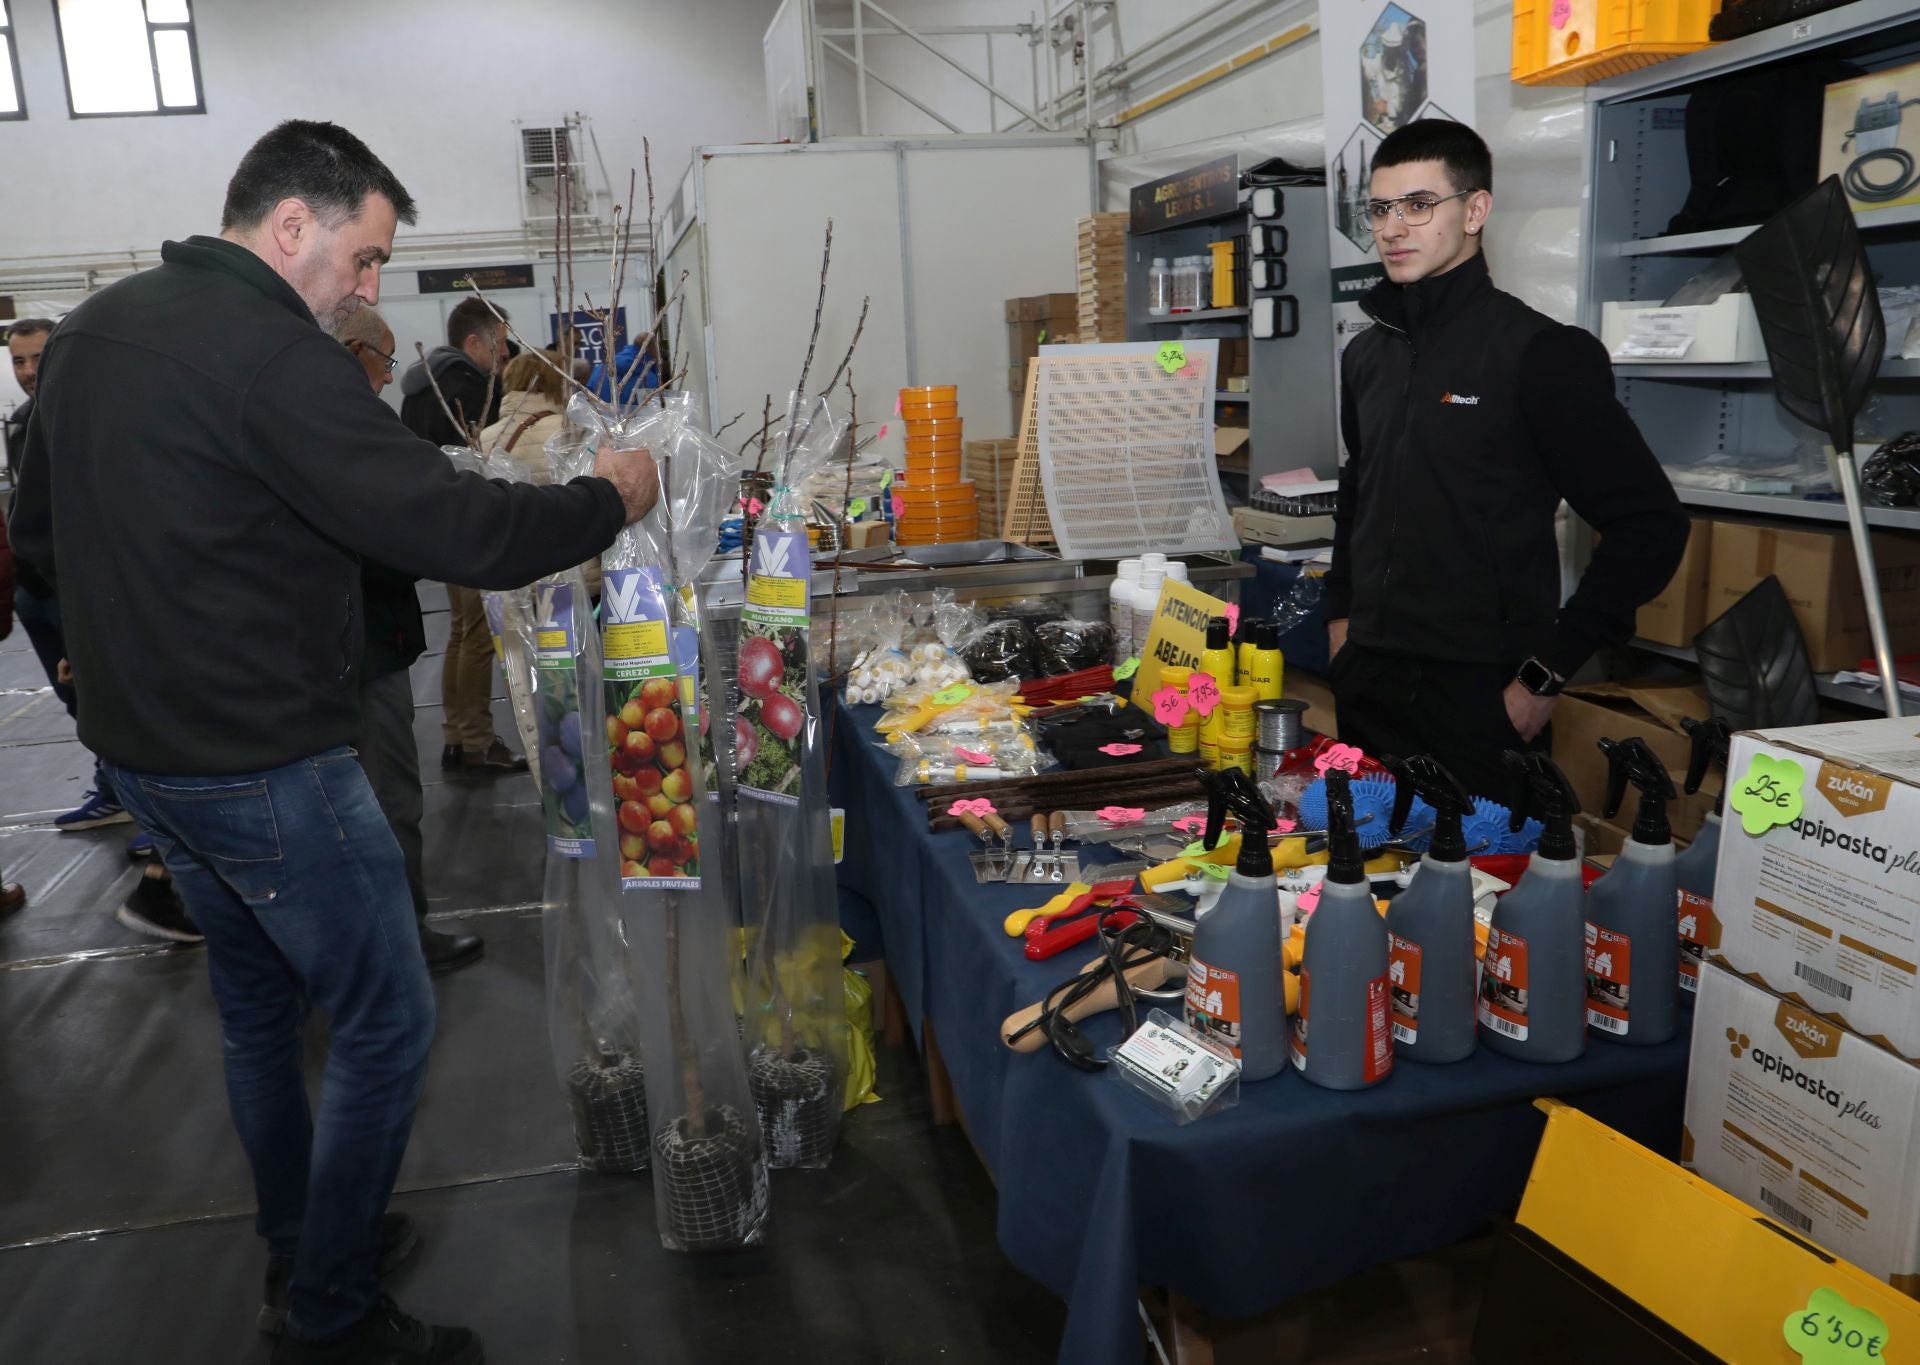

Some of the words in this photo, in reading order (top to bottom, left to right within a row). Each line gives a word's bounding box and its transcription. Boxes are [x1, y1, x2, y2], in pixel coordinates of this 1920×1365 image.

[751, 613, 793, 623] MANZANO
[1154, 638, 1199, 671] ABEJAS
[616, 668, 650, 678] CEREZO
[1161, 695, 1179, 712] 5€
[1191, 682, 1219, 704] 7,95€
[1745, 775, 1791, 807] 25€
[1827, 776, 1873, 801] zukán
[1789, 817, 1888, 865] apipasta
[1884, 849, 1920, 876] plu
[625, 879, 660, 888] ÁRBOLES
[661, 879, 699, 888] FRUTALES
[1160, 1031, 1196, 1055] agrocentros
[1785, 1016, 1826, 1047] zukán
[1752, 1048, 1840, 1108] apipasta
[1838, 1100, 1882, 1130] plus
[1801, 1312, 1881, 1358] 6'50€
